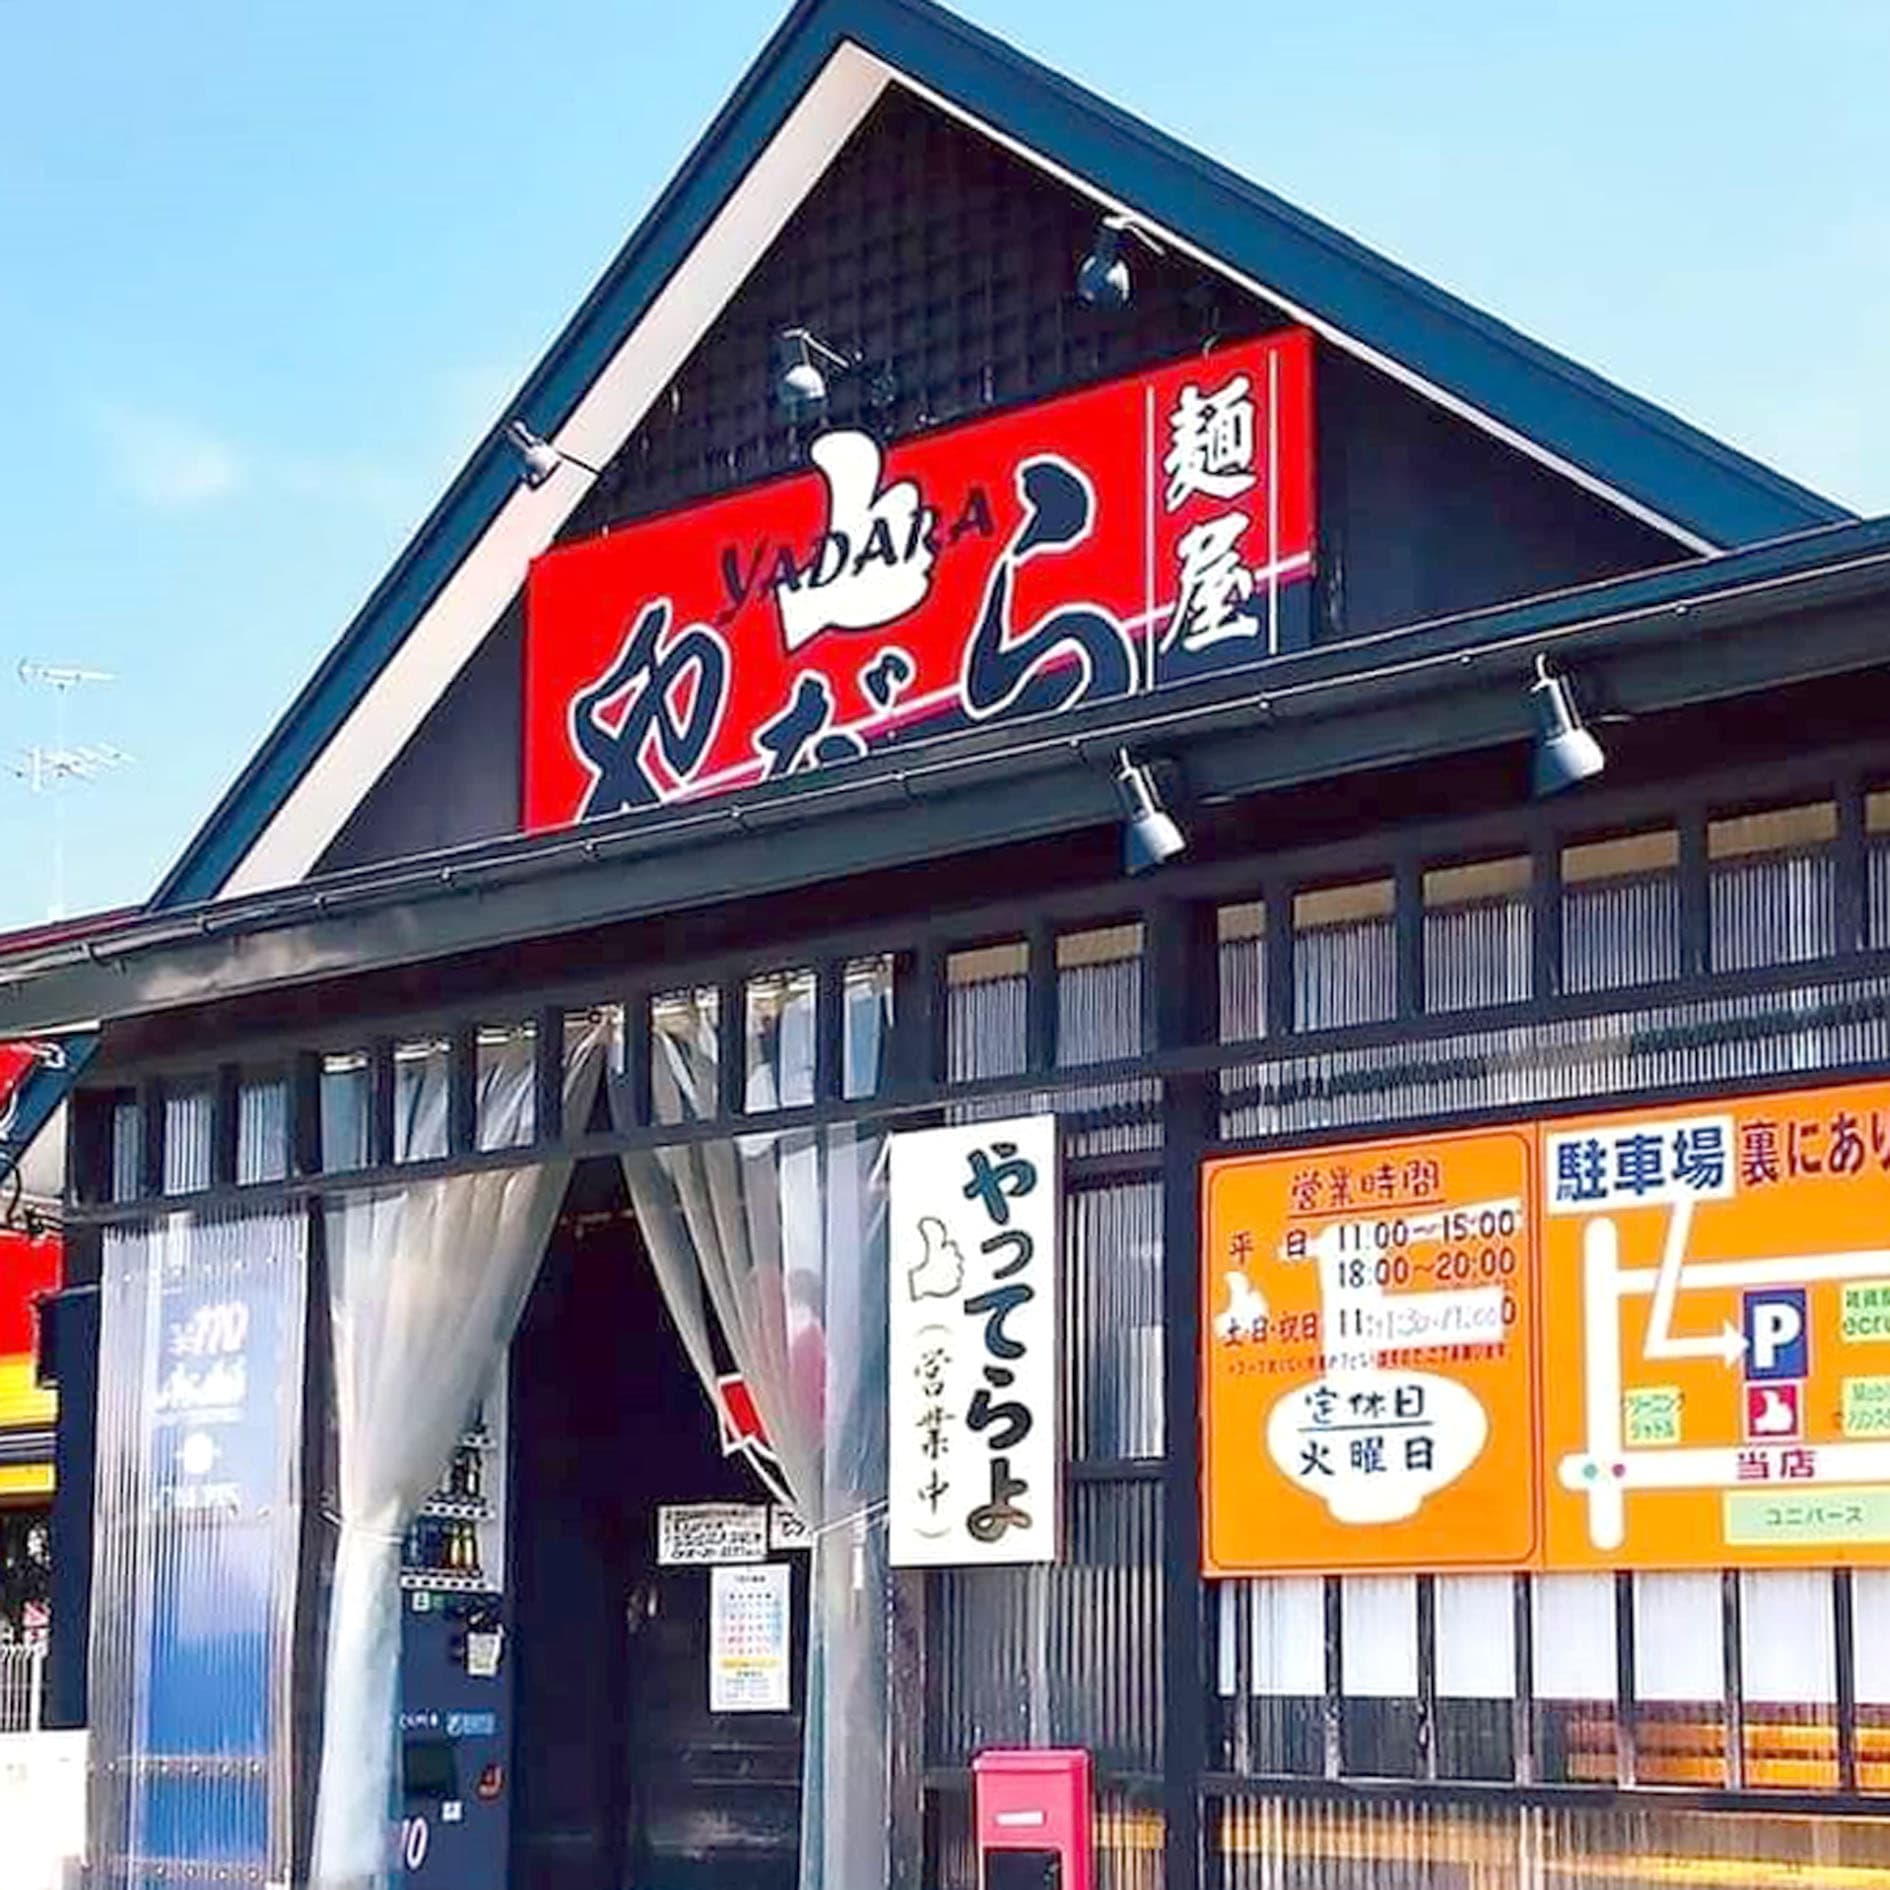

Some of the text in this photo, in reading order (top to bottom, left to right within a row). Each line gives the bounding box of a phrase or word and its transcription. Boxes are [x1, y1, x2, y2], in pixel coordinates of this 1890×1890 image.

[1163, 374, 1258, 656] 麺屋
[715, 485, 994, 626] YADARA
[1291, 1159, 1440, 1210] 営業時間
[1555, 1125, 1726, 1202] 駐車場
[962, 1141, 1038, 1543] やってらよ
[1753, 1302, 1802, 1370] P
[1304, 1384, 1426, 1425] 定休日
[1299, 1435, 1436, 1476] 火曜日
[1737, 1449, 1817, 1480] 当店
